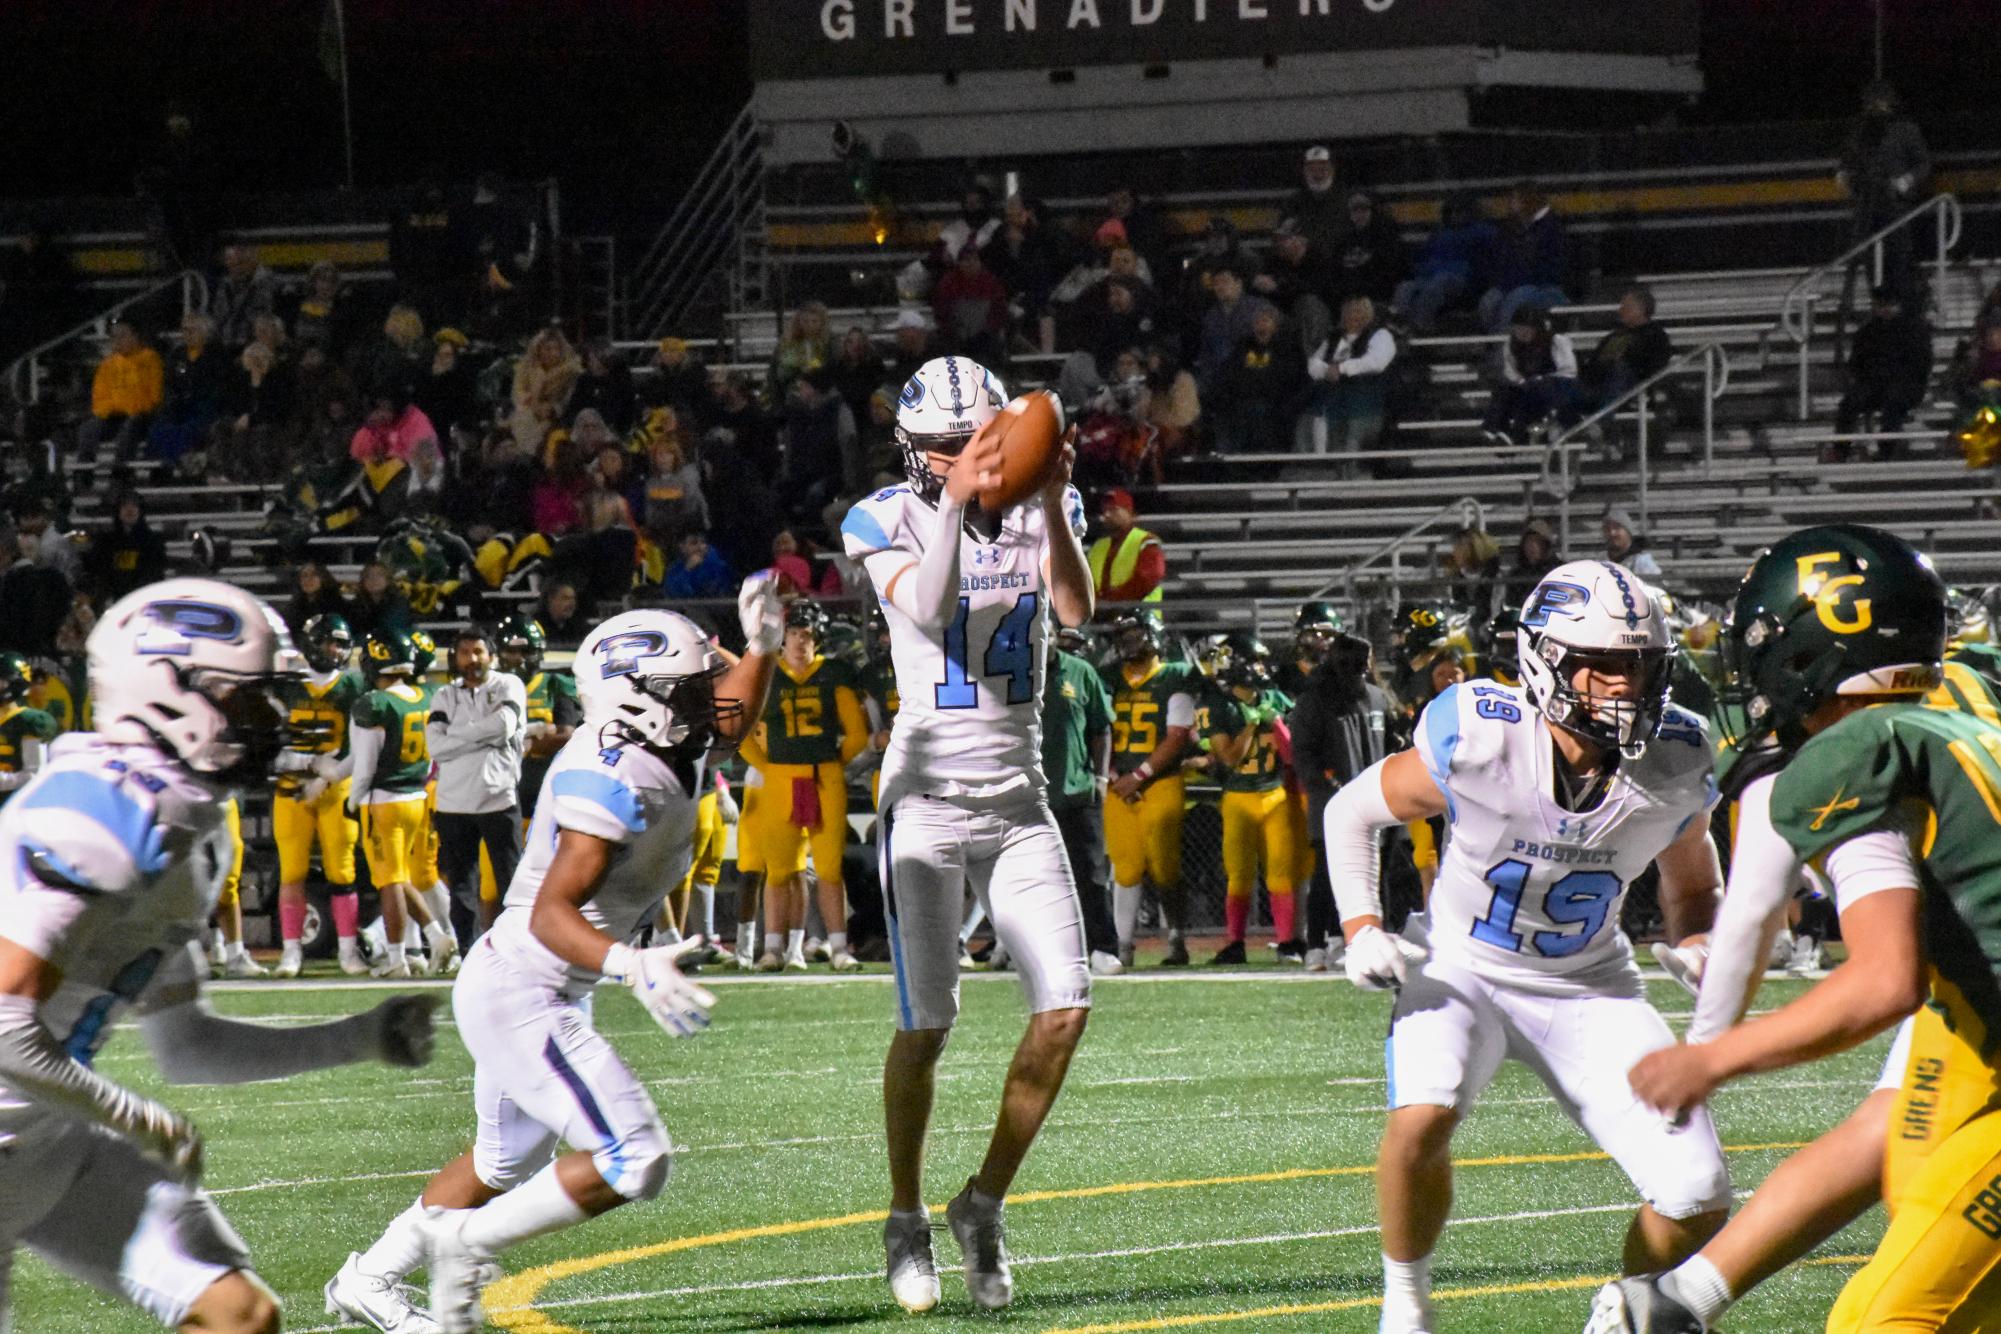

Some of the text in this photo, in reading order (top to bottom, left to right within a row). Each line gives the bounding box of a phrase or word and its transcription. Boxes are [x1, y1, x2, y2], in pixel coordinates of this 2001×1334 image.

[948, 420, 973, 431] TEMPO
[960, 572, 1030, 591] ROSPECT
[1796, 551, 1873, 635] EG
[1523, 580, 1591, 627] P
[138, 600, 243, 655] P
[1621, 633, 1648, 645] TEMPO
[600, 630, 669, 680] P
[934, 591, 1038, 711] 14
[780, 698, 823, 737] 12
[1472, 686, 1522, 724] 19
[1113, 702, 1159, 753] 55
[598, 748, 624, 768] 4
[1512, 838, 1618, 865] PROSPECT
[1469, 857, 1624, 959] 19
